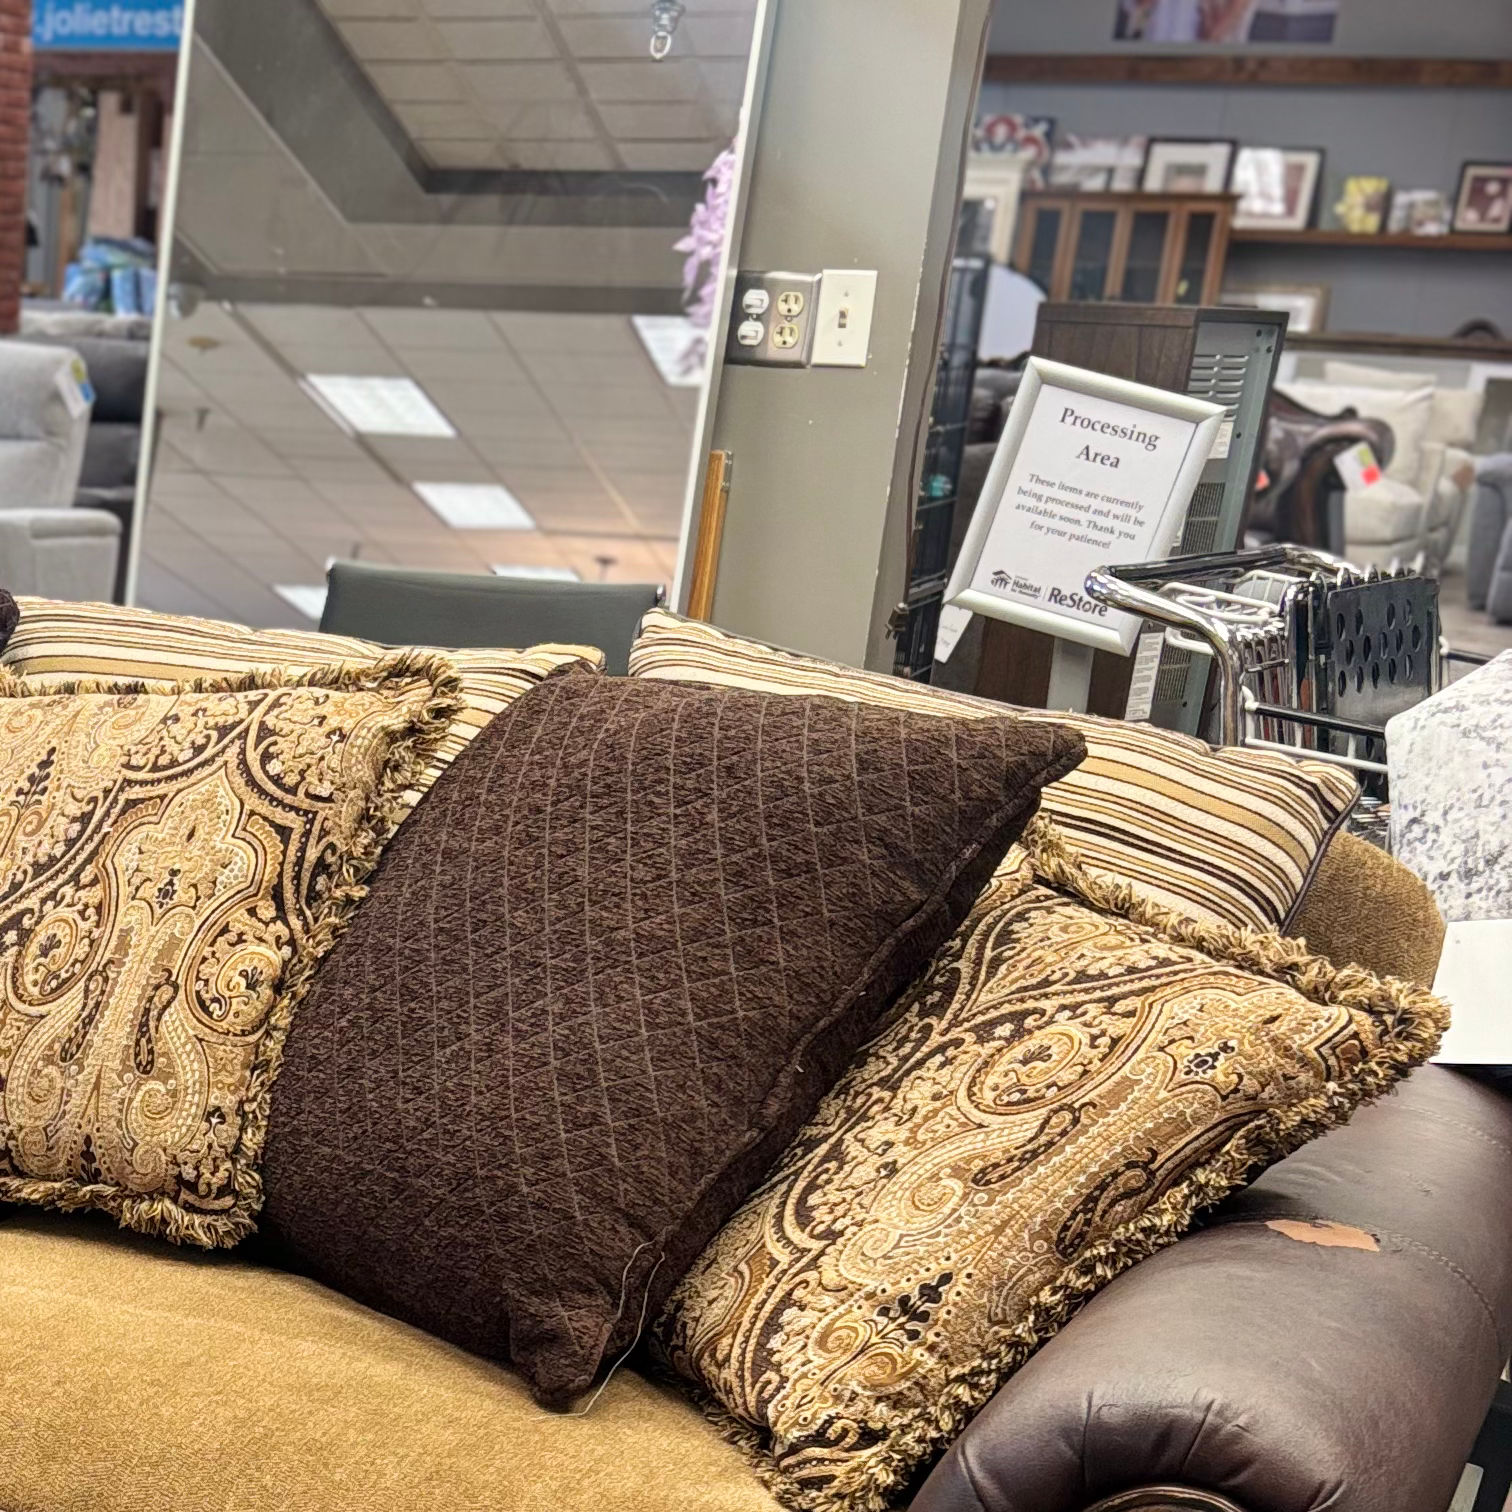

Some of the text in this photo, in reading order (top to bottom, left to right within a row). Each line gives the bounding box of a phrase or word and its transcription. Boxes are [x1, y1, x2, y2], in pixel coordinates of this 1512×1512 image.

[1059, 406, 1160, 451] Processing
[1075, 444, 1121, 469] Area
[1017, 486, 1146, 527] being processed and will be
[1029, 473, 1144, 513] These items are currently
[1015, 503, 1136, 541] available soon. Thank you
[1029, 520, 1112, 549] for your patience!
[1012, 579, 1042, 594] Habitat
[1048, 587, 1108, 617] ReStore
